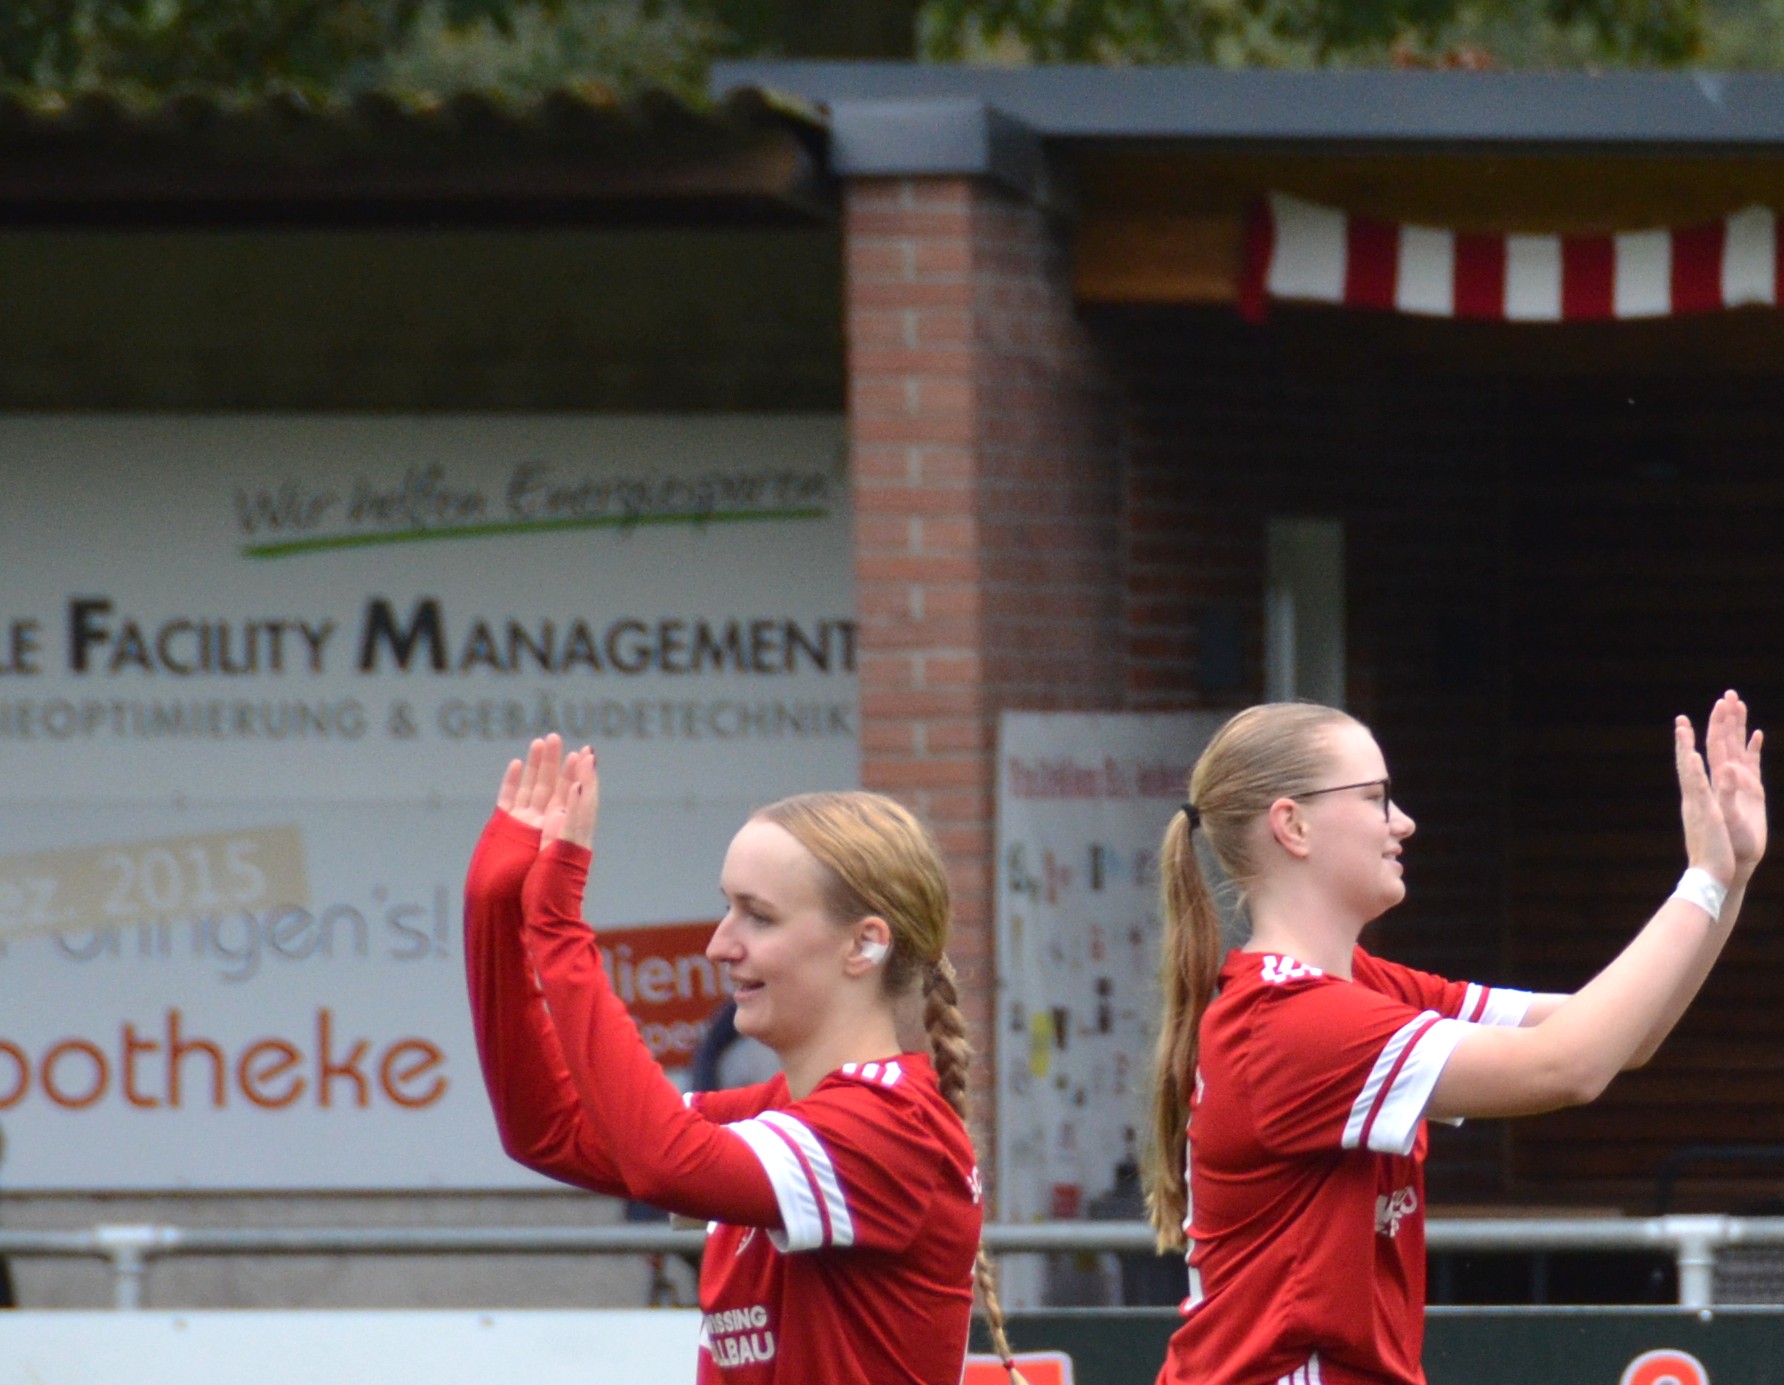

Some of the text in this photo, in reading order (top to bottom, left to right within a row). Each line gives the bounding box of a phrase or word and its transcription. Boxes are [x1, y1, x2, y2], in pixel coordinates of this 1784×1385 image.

[68, 596, 334, 674] FACILITY
[357, 596, 859, 674] MANAGEMENT
[390, 702, 418, 740] &
[437, 688, 853, 741] GEBÄUDETECHNIK
[100, 839, 267, 915] 2015
